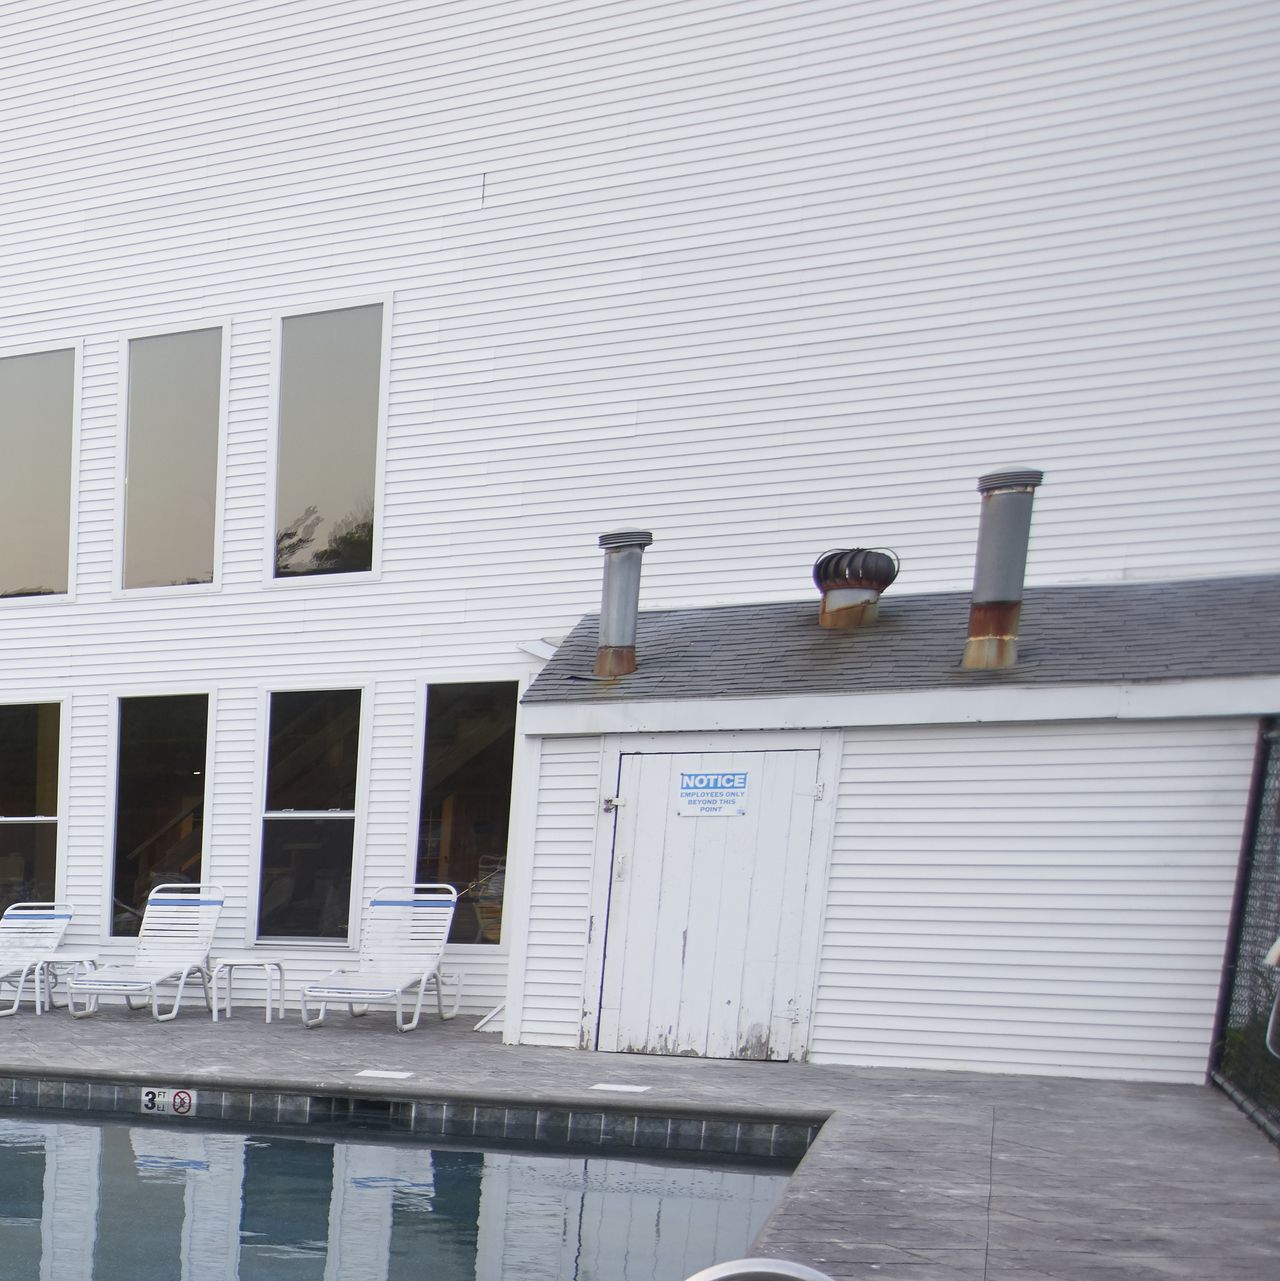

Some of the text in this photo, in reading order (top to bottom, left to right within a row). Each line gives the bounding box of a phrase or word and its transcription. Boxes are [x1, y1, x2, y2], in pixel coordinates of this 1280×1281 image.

[682, 774, 745, 788] NOTICE
[144, 1091, 167, 1110] 3 FT
